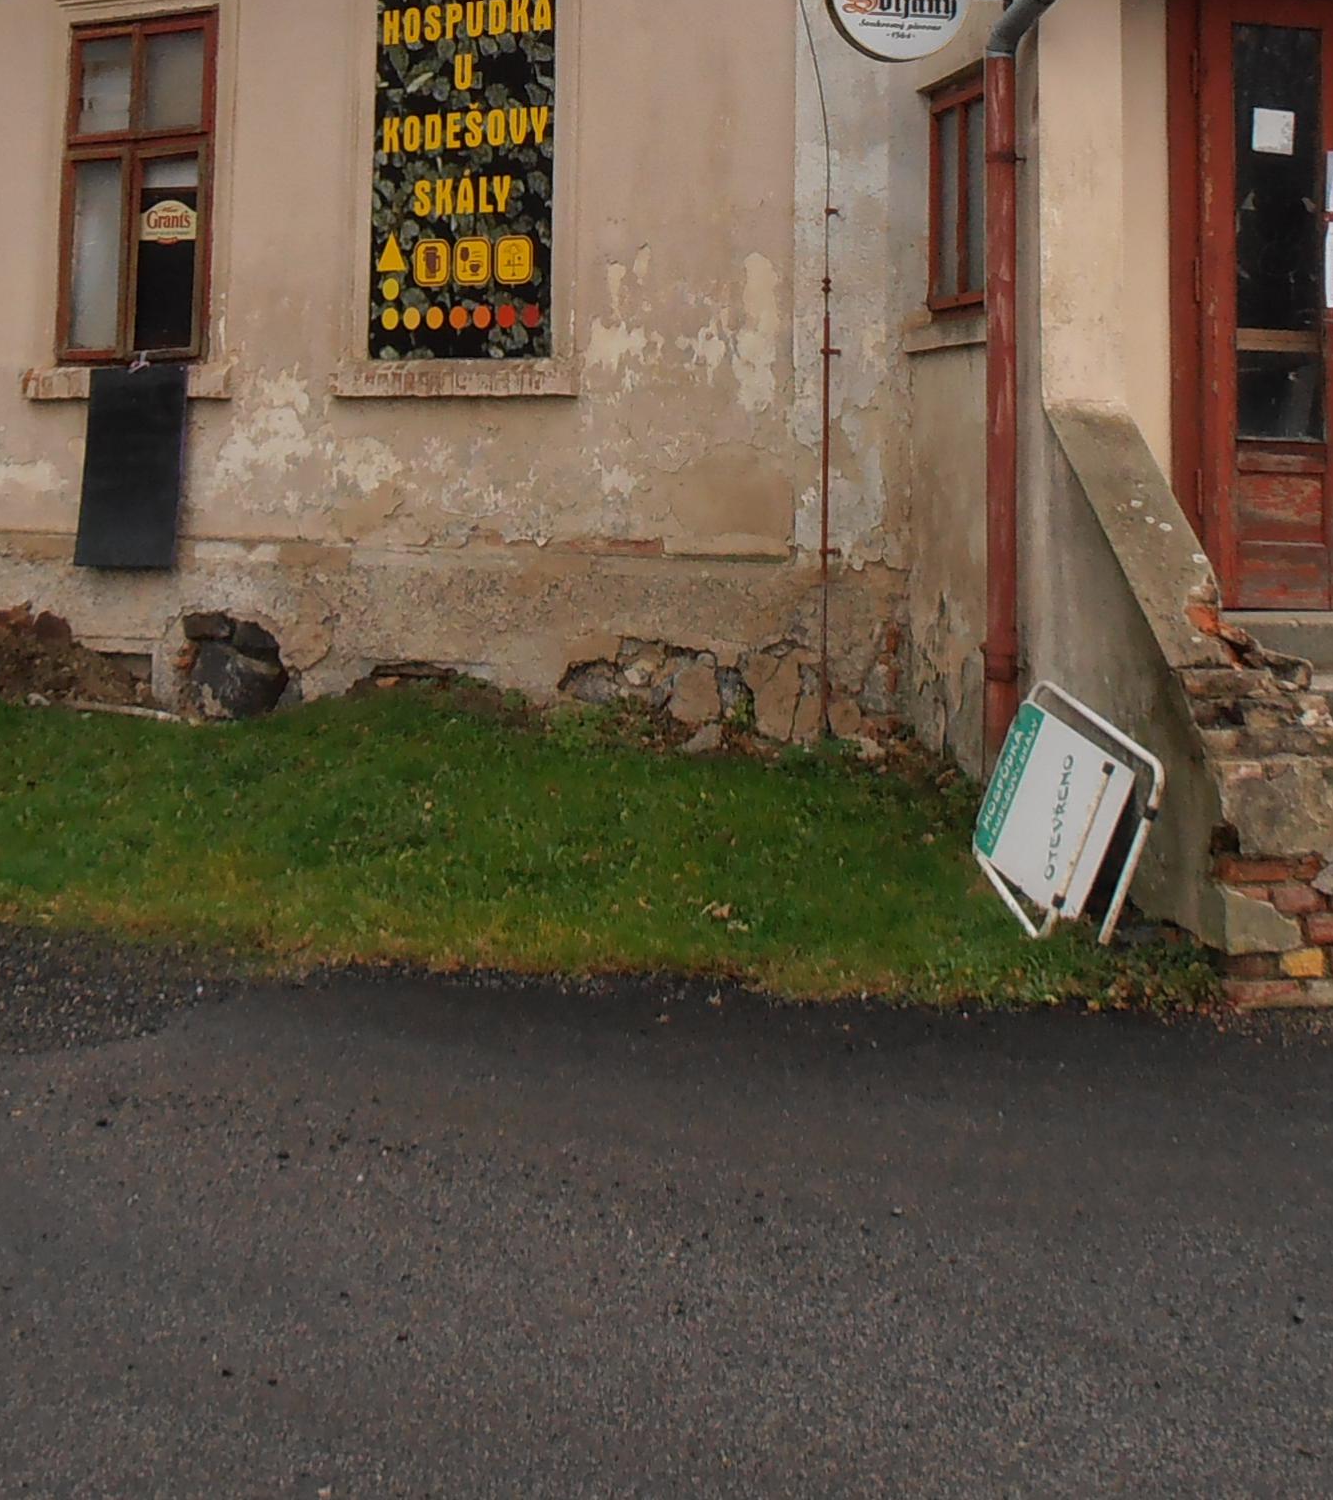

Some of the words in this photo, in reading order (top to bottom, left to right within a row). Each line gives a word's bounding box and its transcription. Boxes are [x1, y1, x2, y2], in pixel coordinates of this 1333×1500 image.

[454, 54, 472, 91] U
[383, 103, 548, 153] KODEŠOVY
[414, 169, 511, 217] SKÁLY
